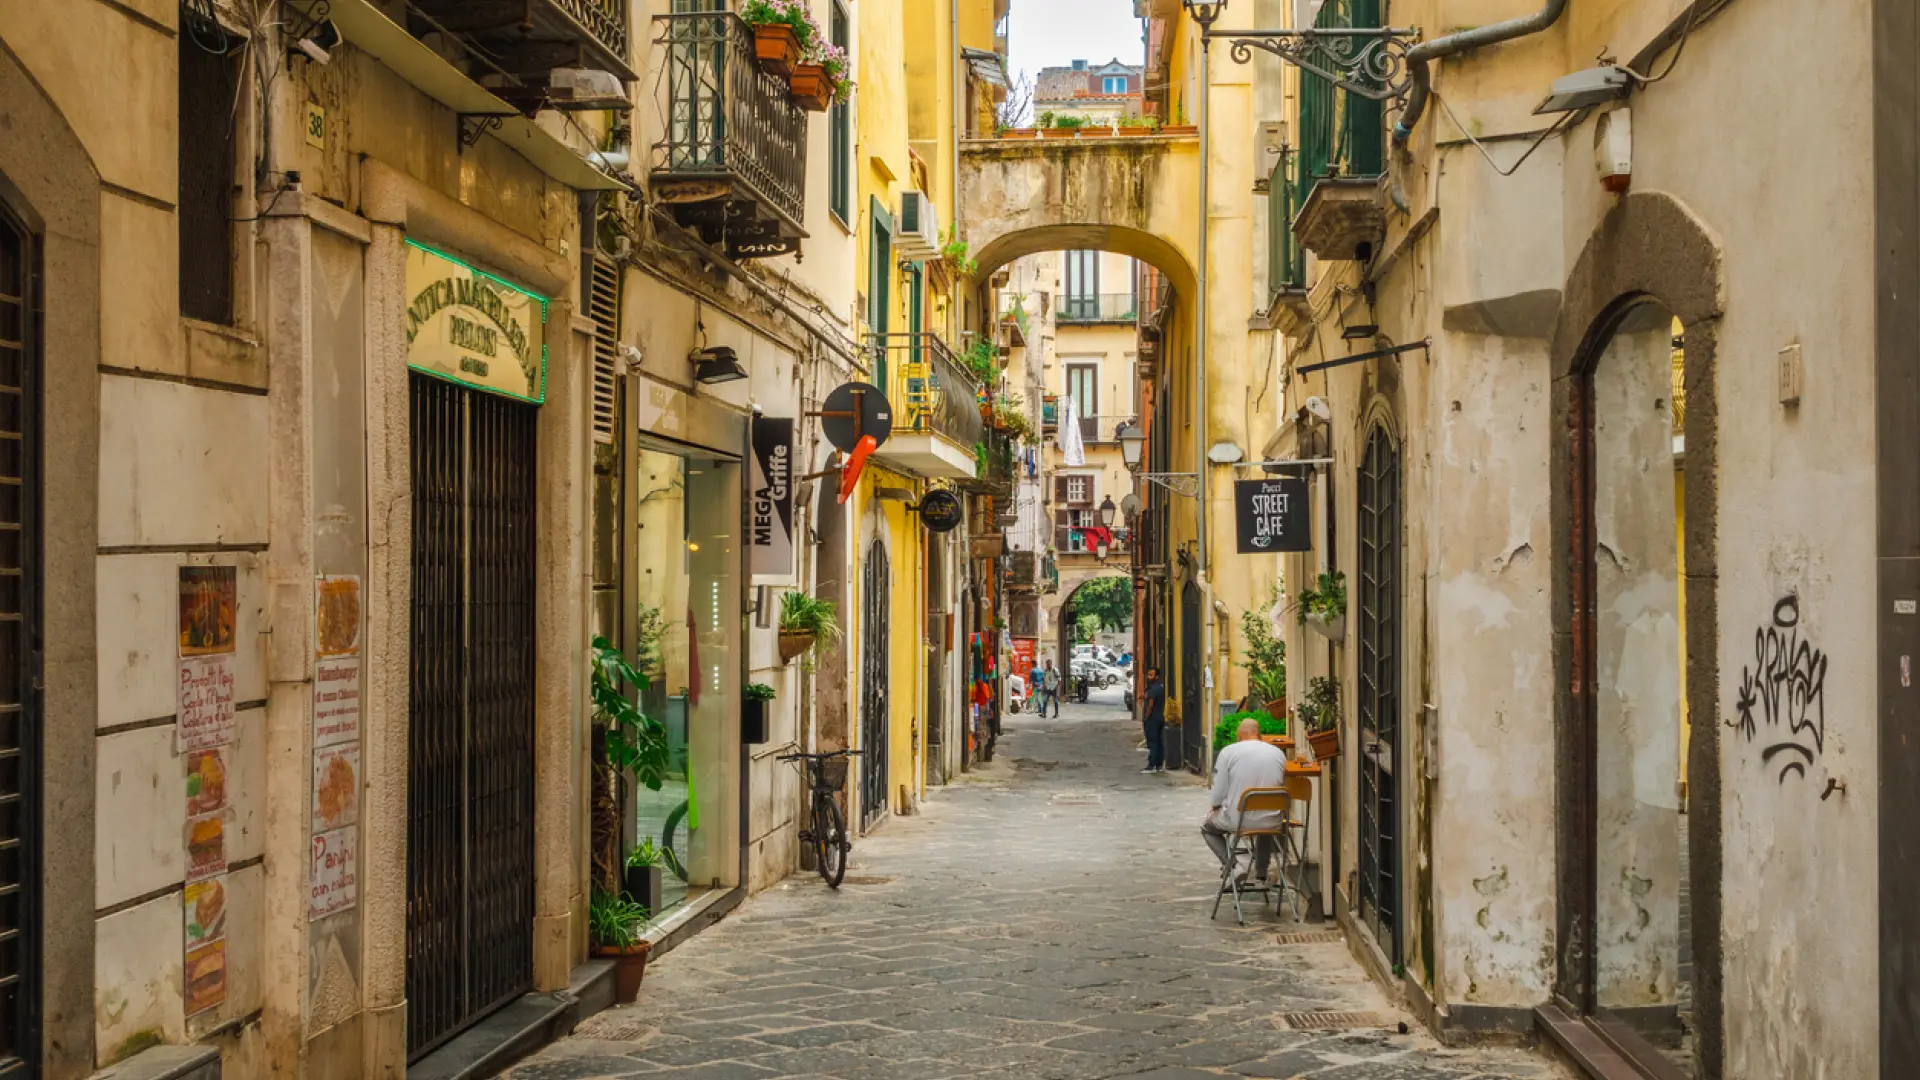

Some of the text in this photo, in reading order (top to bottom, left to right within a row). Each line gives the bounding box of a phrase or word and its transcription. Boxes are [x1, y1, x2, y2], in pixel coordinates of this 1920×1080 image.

[309, 112, 322, 138] 38
[769, 444, 788, 501] Griffe
[755, 485, 772, 546] MEGA
[1252, 494, 1289, 514] STREET
